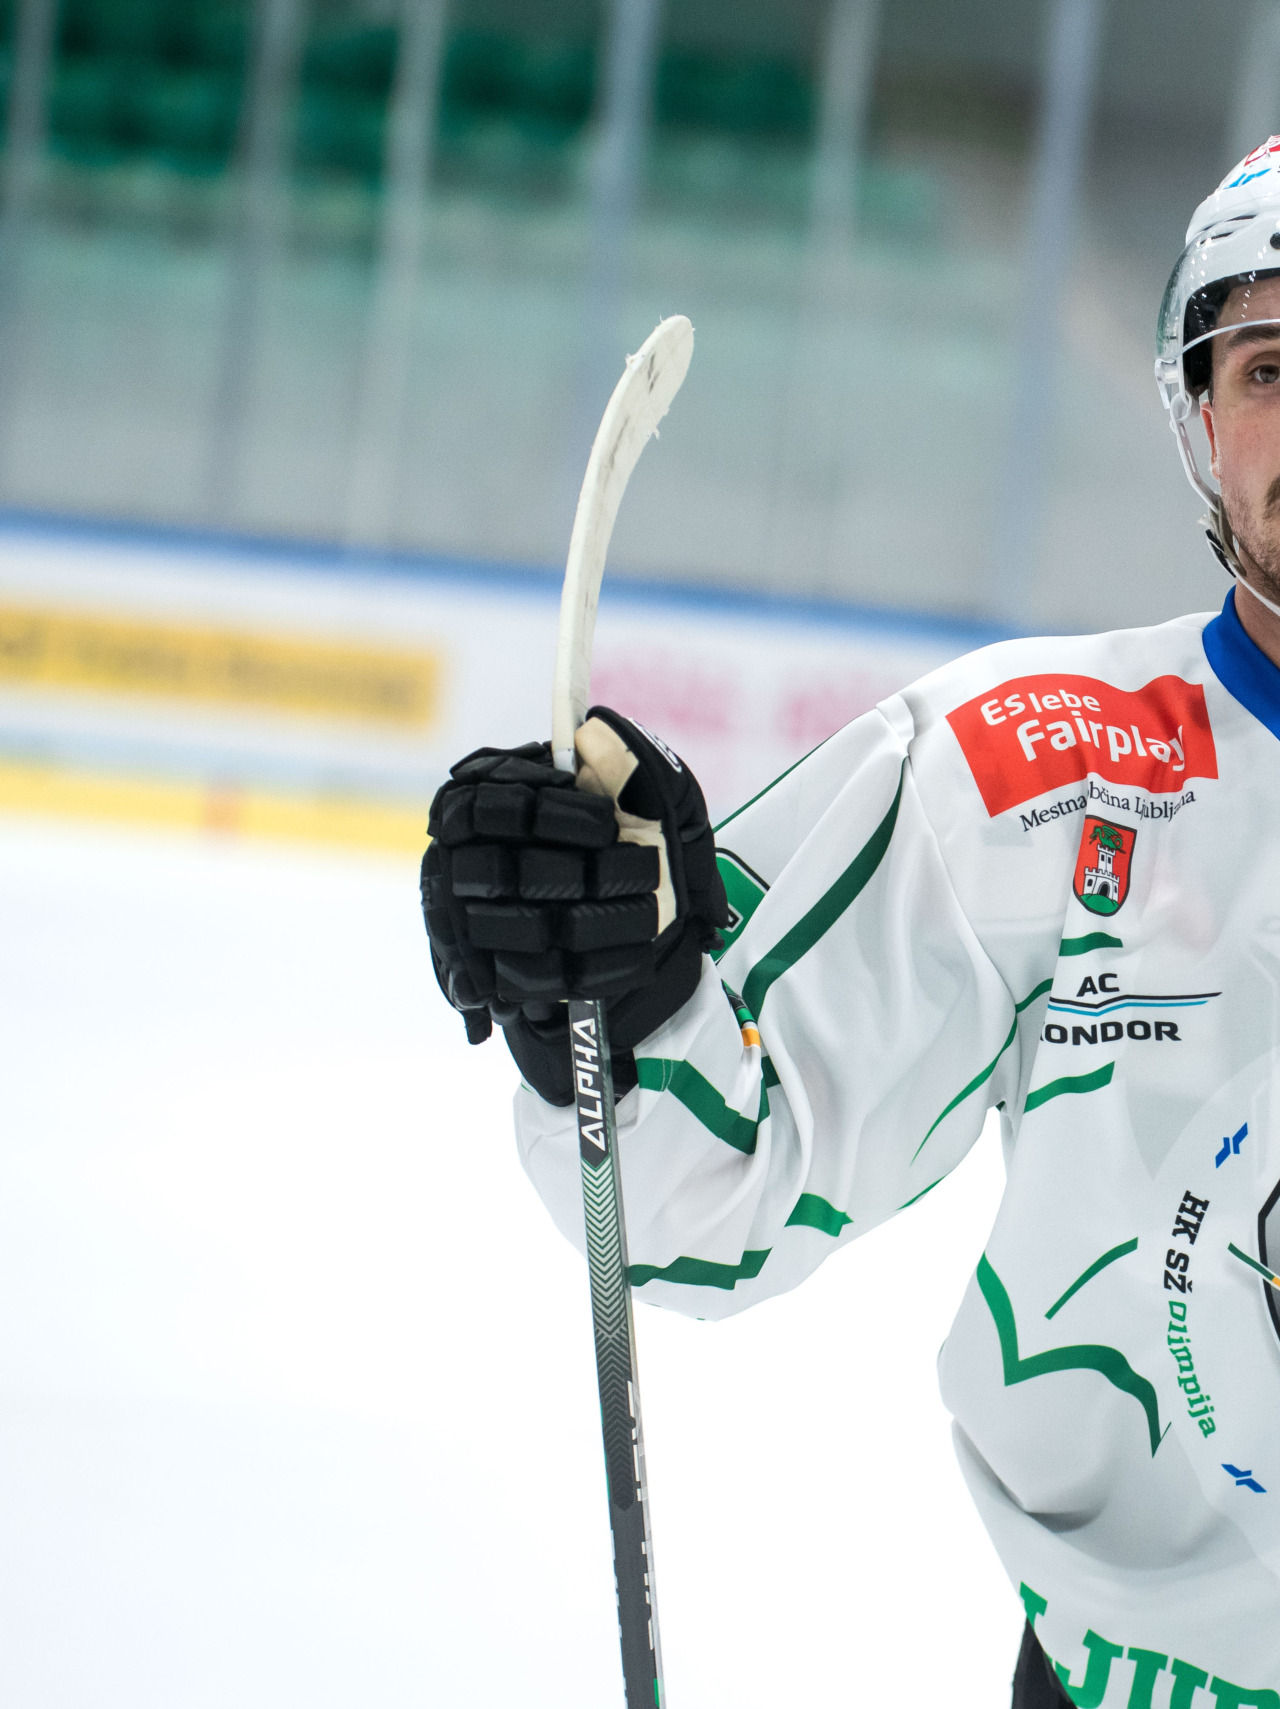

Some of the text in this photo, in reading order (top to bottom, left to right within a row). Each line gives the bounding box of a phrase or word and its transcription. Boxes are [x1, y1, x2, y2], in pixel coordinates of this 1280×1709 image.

[1028, 689, 1101, 713] lebe
[1016, 710, 1185, 772] Fairplay
[1019, 794, 1088, 832] Mestna
[1087, 780, 1131, 811] bčina
[1076, 973, 1120, 997] AC
[1040, 1020, 1182, 1046] ONDOR
[572, 1017, 607, 1152] ALPHA
[1163, 1190, 1217, 1439] HK SŽ Olimpija
